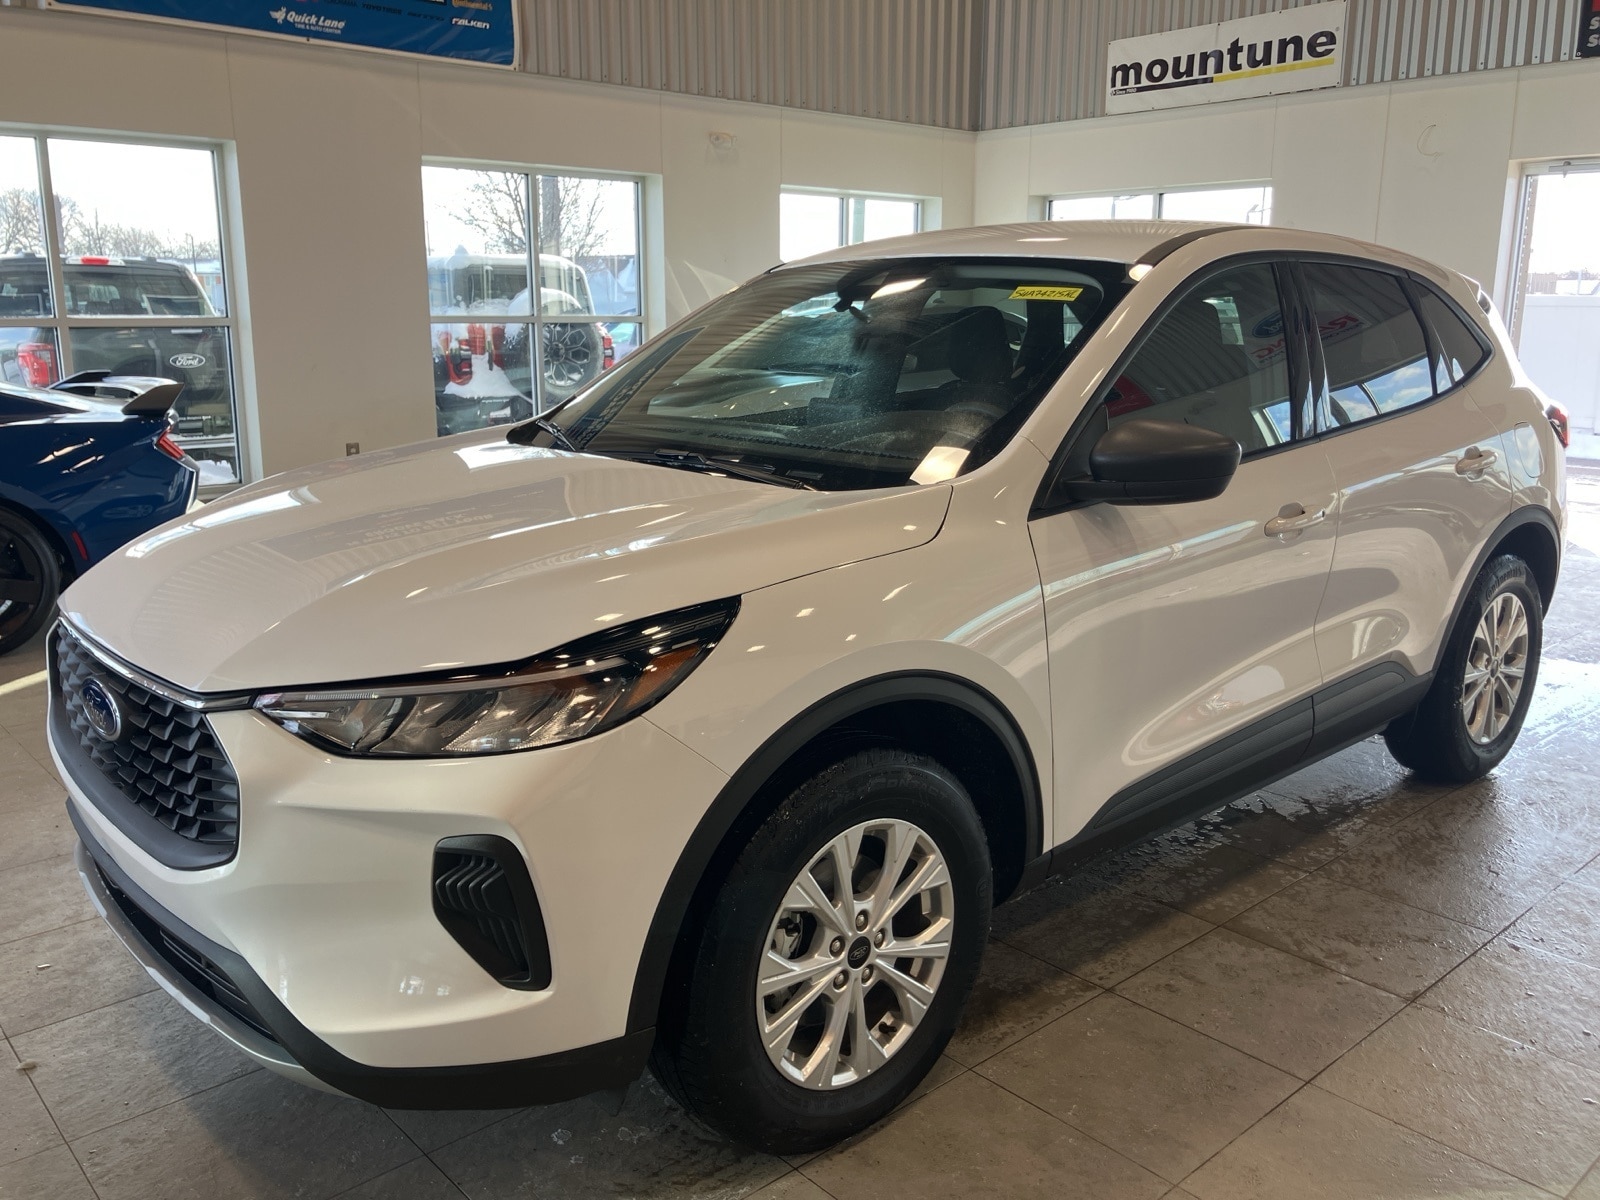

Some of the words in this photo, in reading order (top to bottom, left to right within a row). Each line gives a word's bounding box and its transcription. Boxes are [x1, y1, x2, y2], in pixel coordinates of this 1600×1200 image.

[287, 11, 317, 25] Quick
[318, 16, 346, 29] Lane
[452, 17, 490, 30] FALKEN
[1110, 30, 1337, 88] mountune
